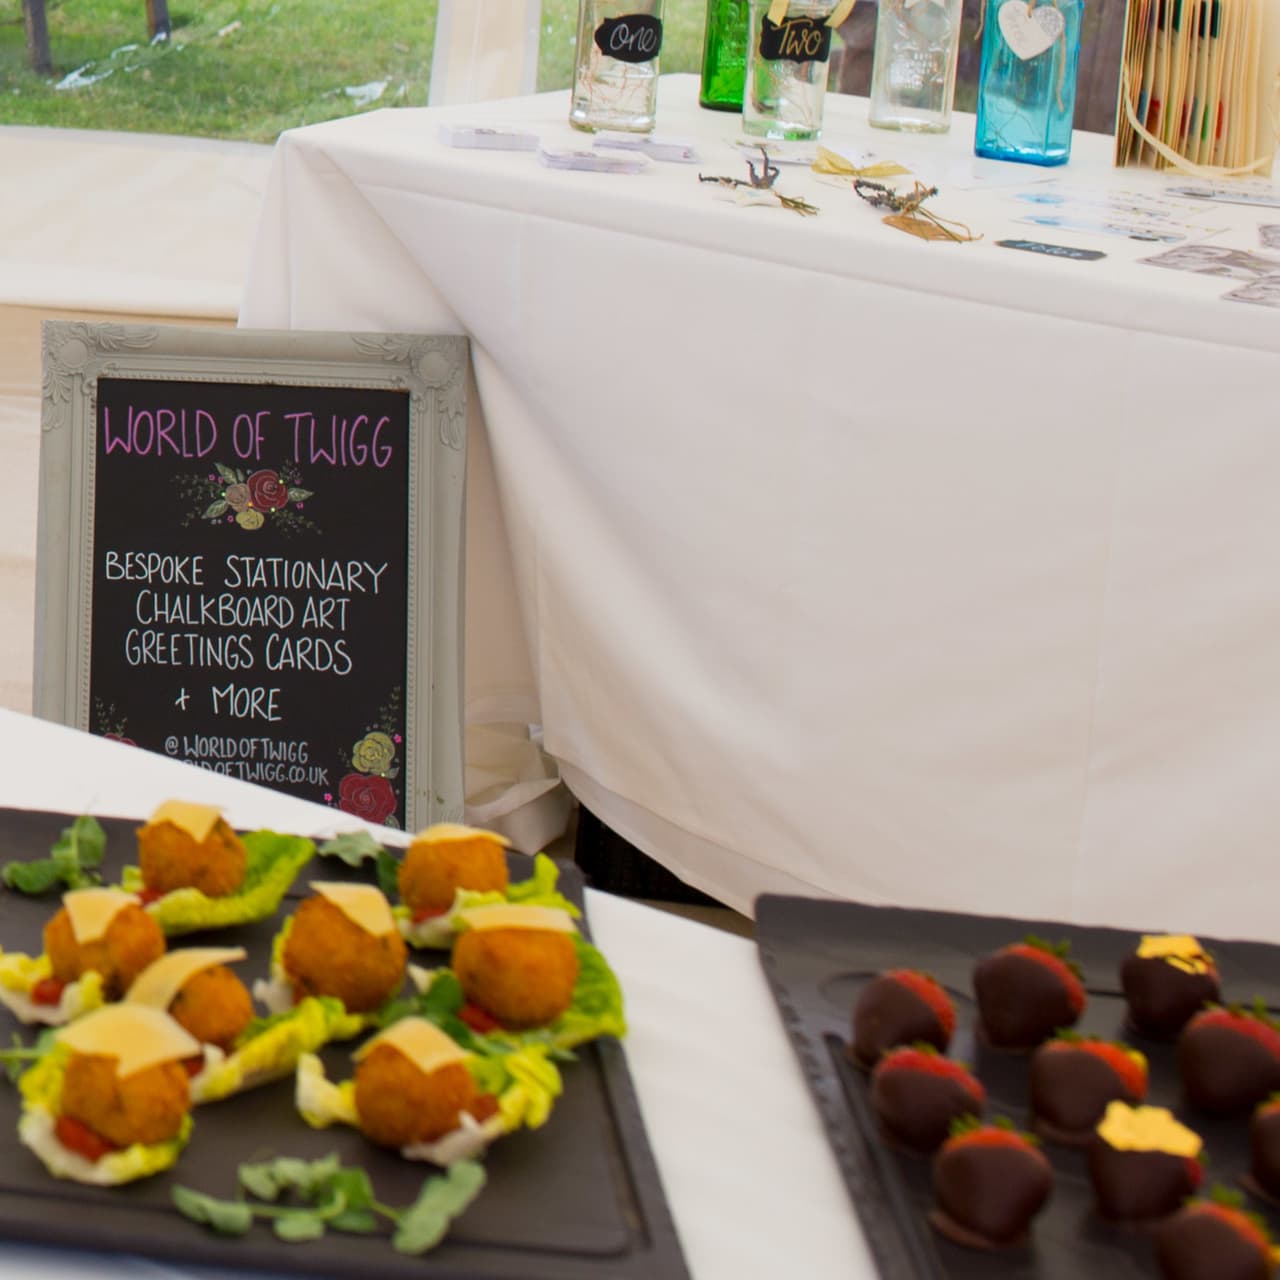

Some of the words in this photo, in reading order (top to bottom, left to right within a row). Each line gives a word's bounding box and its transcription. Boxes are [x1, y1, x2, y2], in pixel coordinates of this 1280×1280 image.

[771, 19, 822, 56] Two
[104, 406, 217, 458] WORLD
[233, 411, 271, 460] OF
[284, 411, 393, 468] TWIGG
[105, 551, 204, 586] BESPOKE
[224, 556, 388, 594] STATIONARY
[136, 589, 294, 629] CHALKBOARD
[302, 597, 351, 631] ART
[125, 628, 254, 670] GREETINGS
[266, 634, 353, 675] CARDS
[212, 684, 282, 721] MORE
